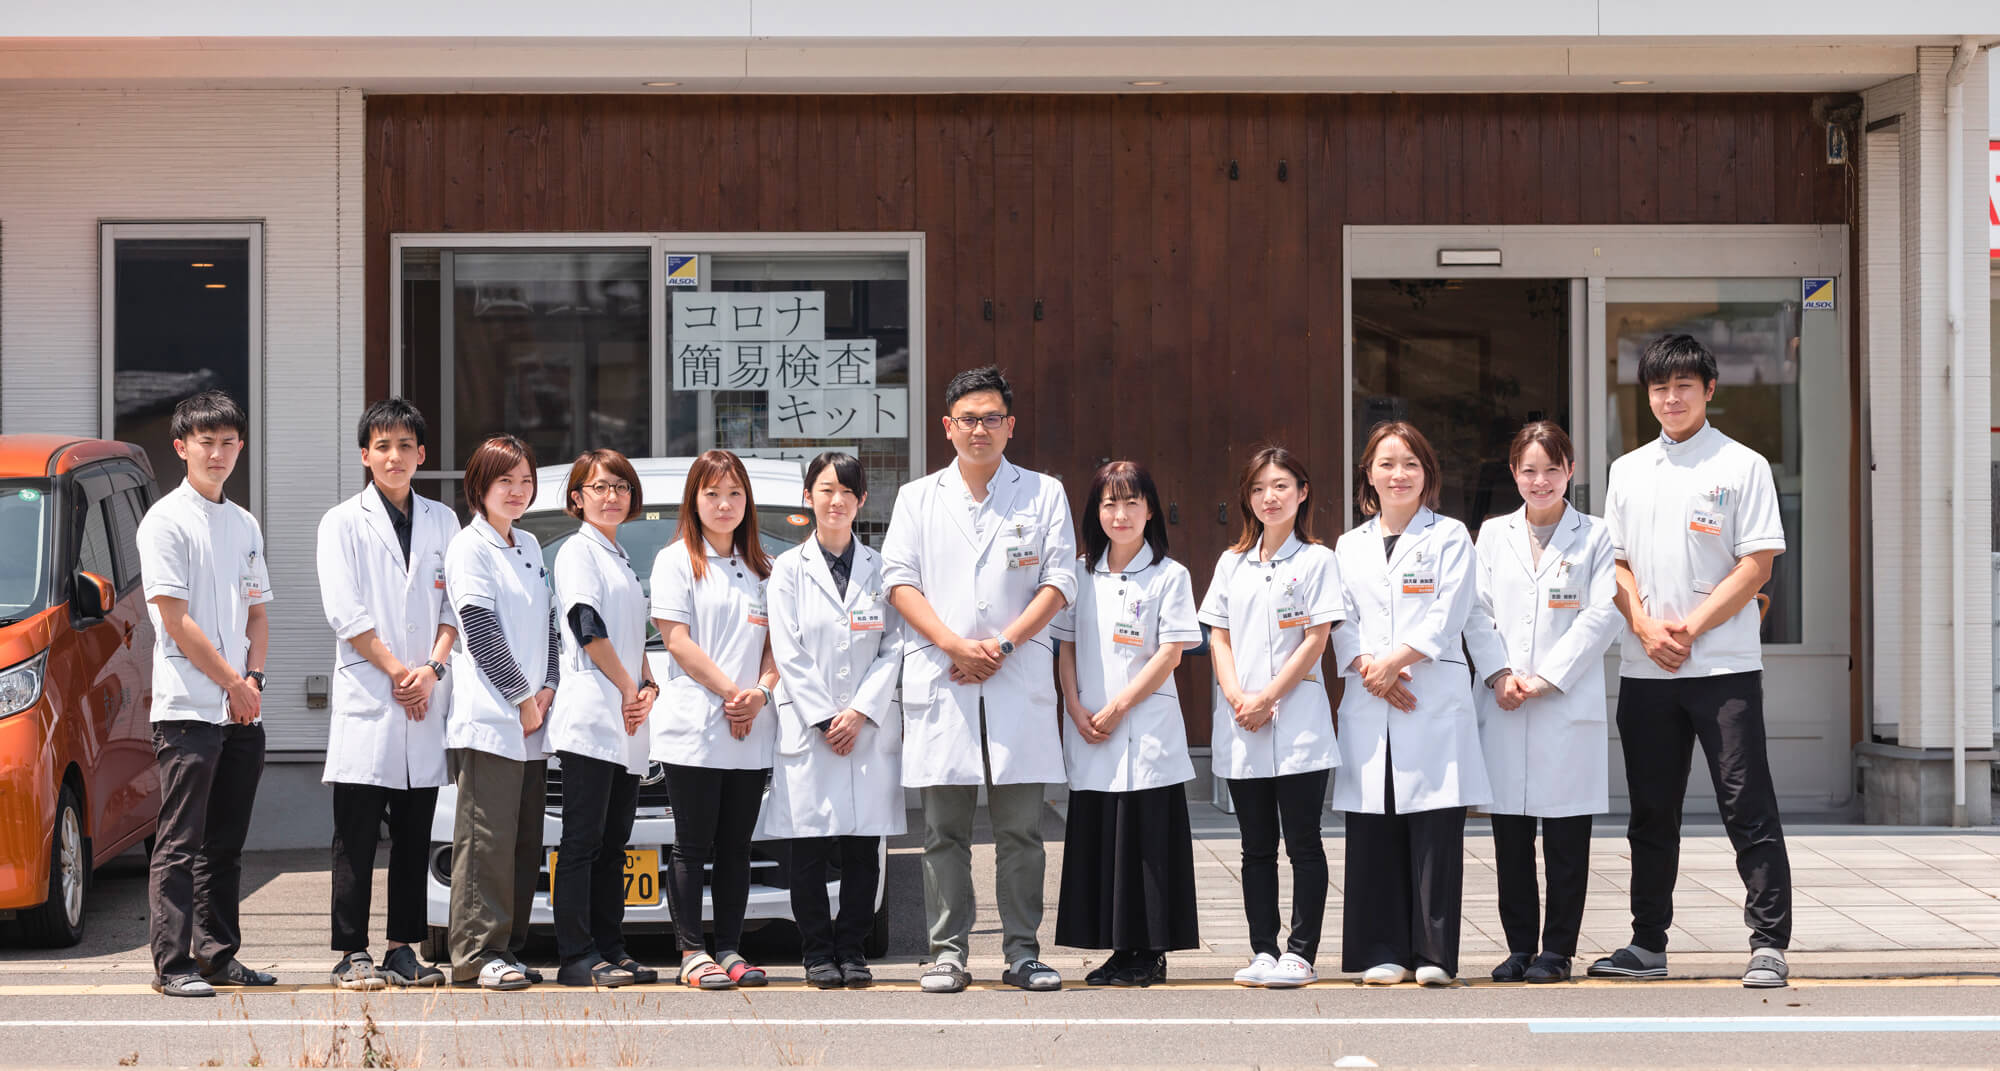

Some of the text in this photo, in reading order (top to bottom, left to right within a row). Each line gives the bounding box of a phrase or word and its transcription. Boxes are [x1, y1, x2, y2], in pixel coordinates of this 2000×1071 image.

[685, 297, 819, 336] コロナ
[678, 343, 871, 389] 簡易検査
[778, 394, 896, 436] キット
